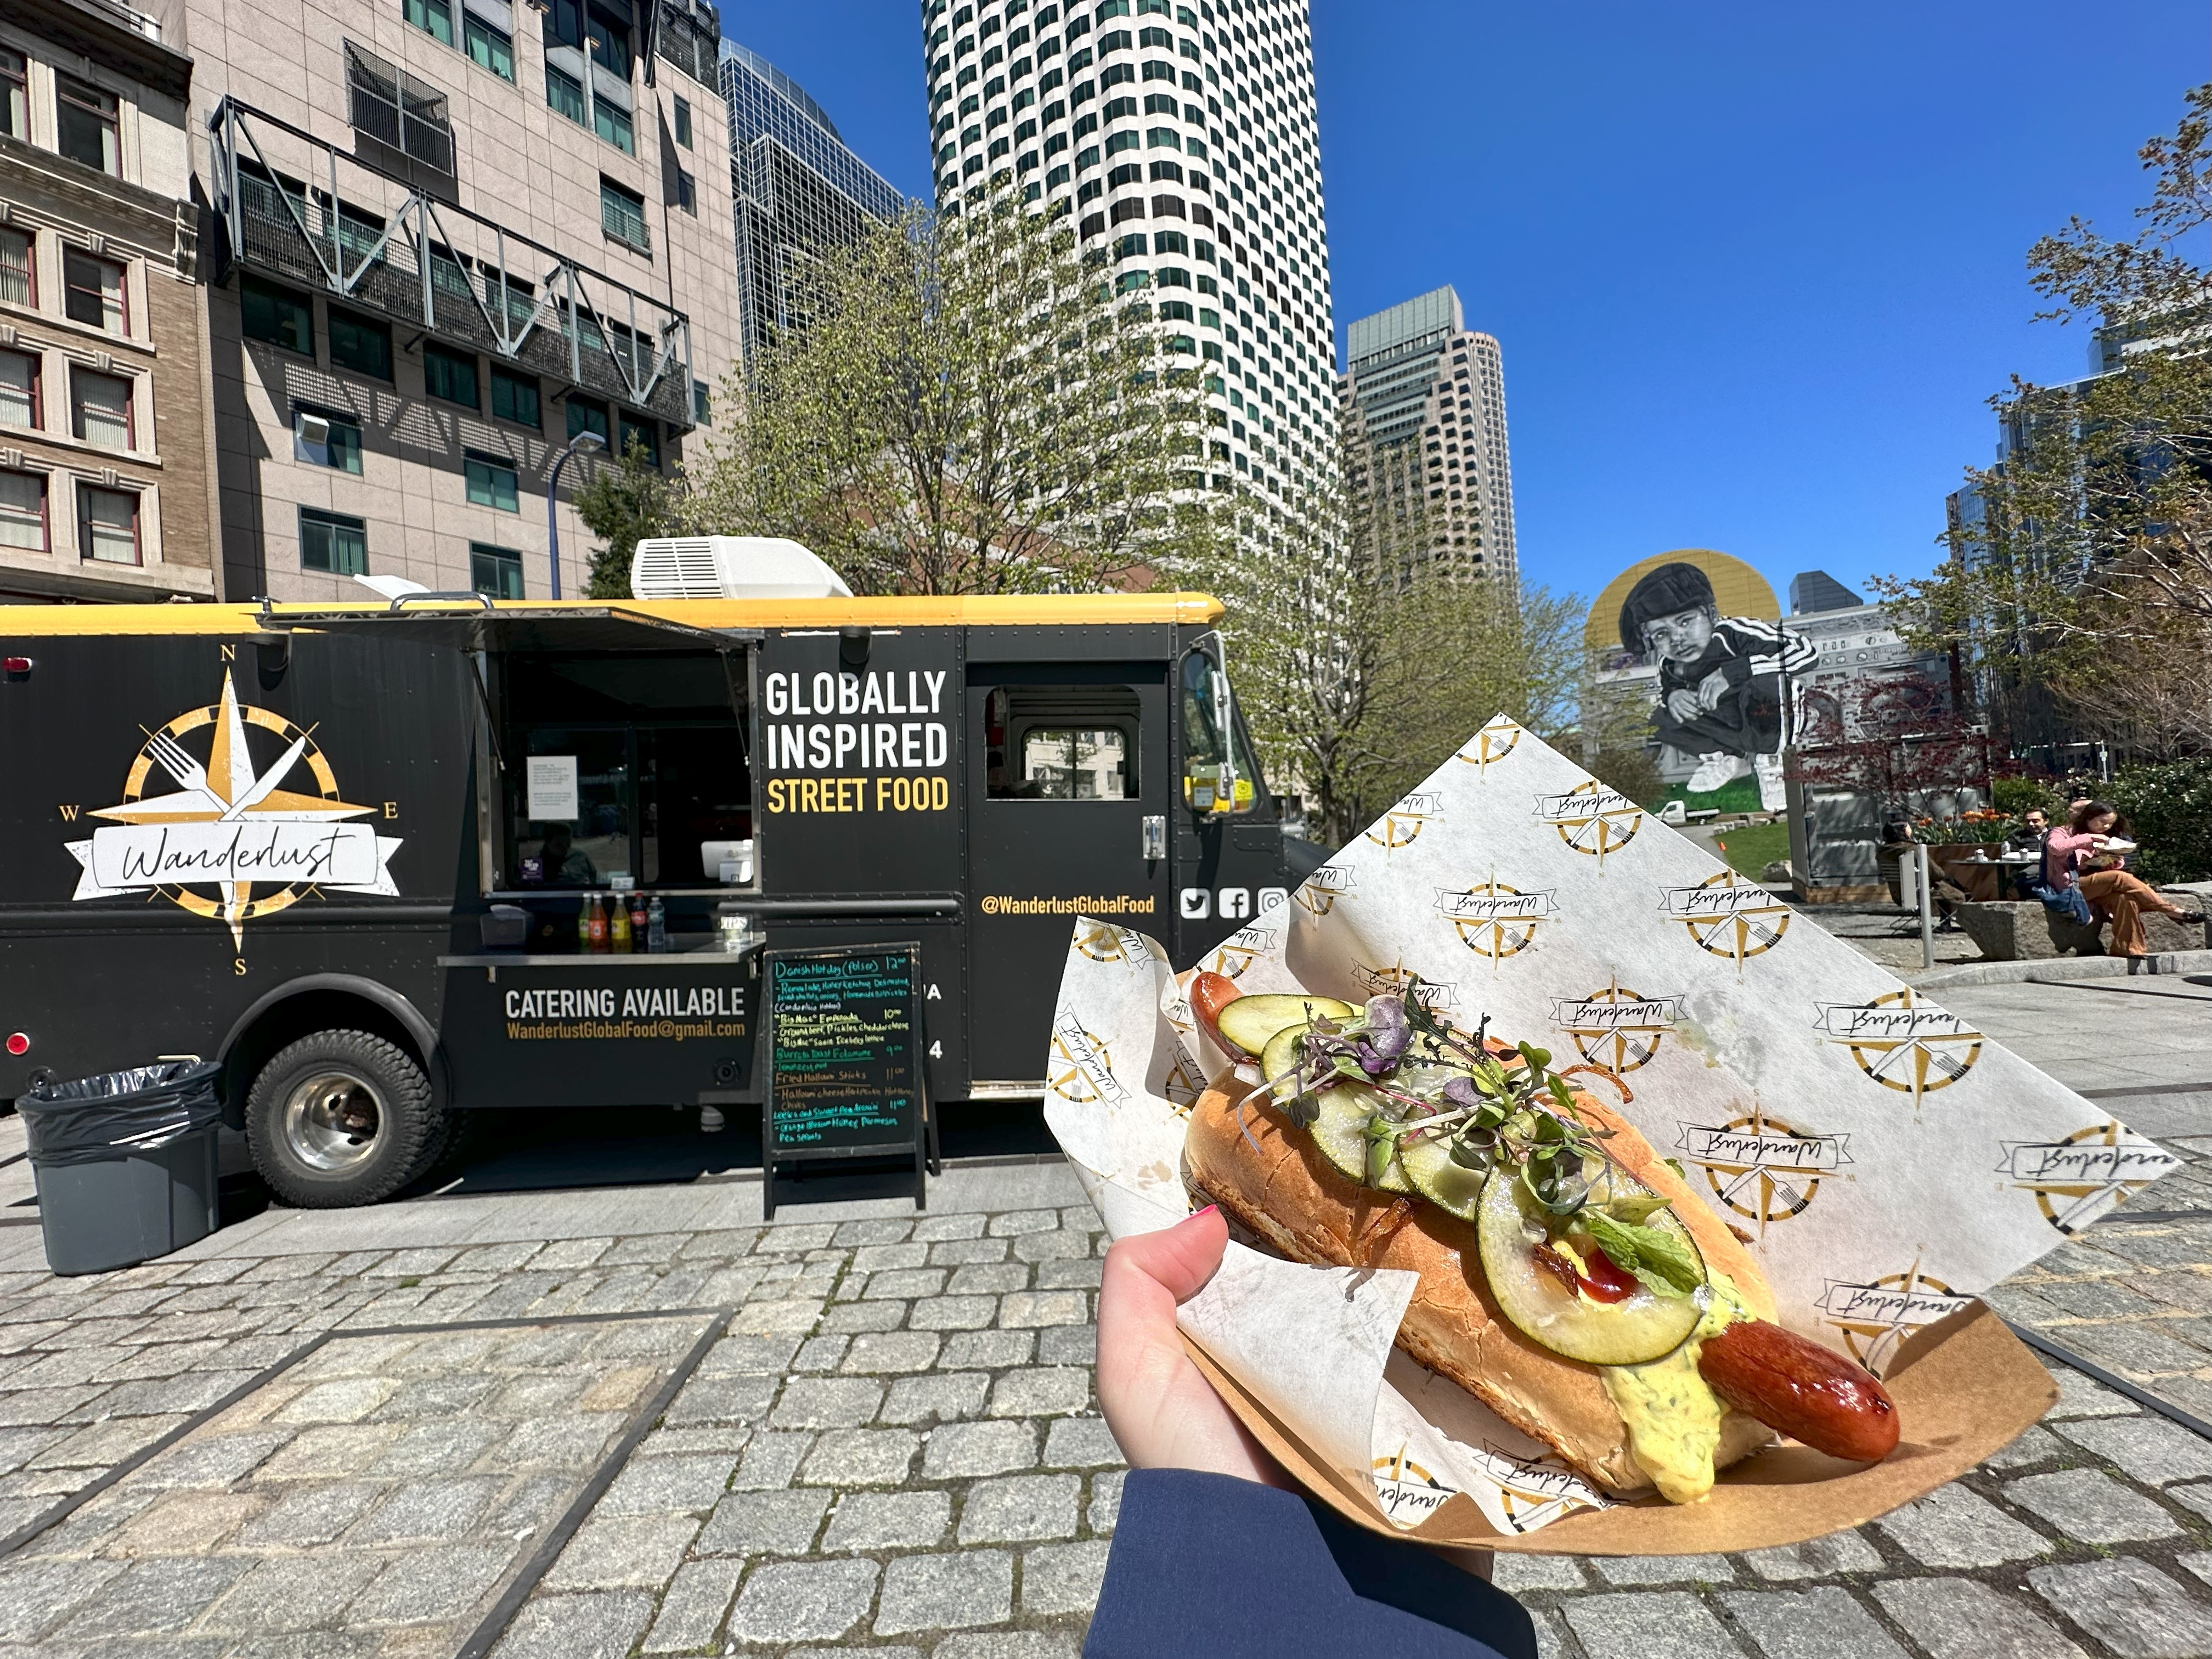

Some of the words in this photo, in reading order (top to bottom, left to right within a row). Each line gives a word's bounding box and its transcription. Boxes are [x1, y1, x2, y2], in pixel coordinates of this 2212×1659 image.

[221, 644, 236, 661] N
[766, 670, 946, 715] GLOBALLY
[768, 723, 947, 769] INSPIRED
[768, 777, 866, 813] STREET
[877, 777, 949, 812] FOOD
[58, 805, 80, 822] W
[384, 801, 398, 819] E
[123, 825, 356, 880] Wanderlust
[981, 895, 1155, 916] @WanderlustGlobalFood
[1449, 896, 1537, 915] Wanderlust
[235, 958, 247, 975] S
[775, 962, 810, 979] Danish
[1364, 973, 1441, 1005] Waderlust
[506, 989, 616, 1019] CATERING
[622, 988, 745, 1017] AVAILABLE
[1567, 1003, 1662, 1025] Wanderlust
[506, 1019, 746, 1041] WanderlustGlobalFood@gmail.com
[1060, 1025, 1116, 1090] Wanderlust
[1697, 1133, 1821, 1165] Wanderlust
[2025, 1146, 2176, 1178] anderlust
